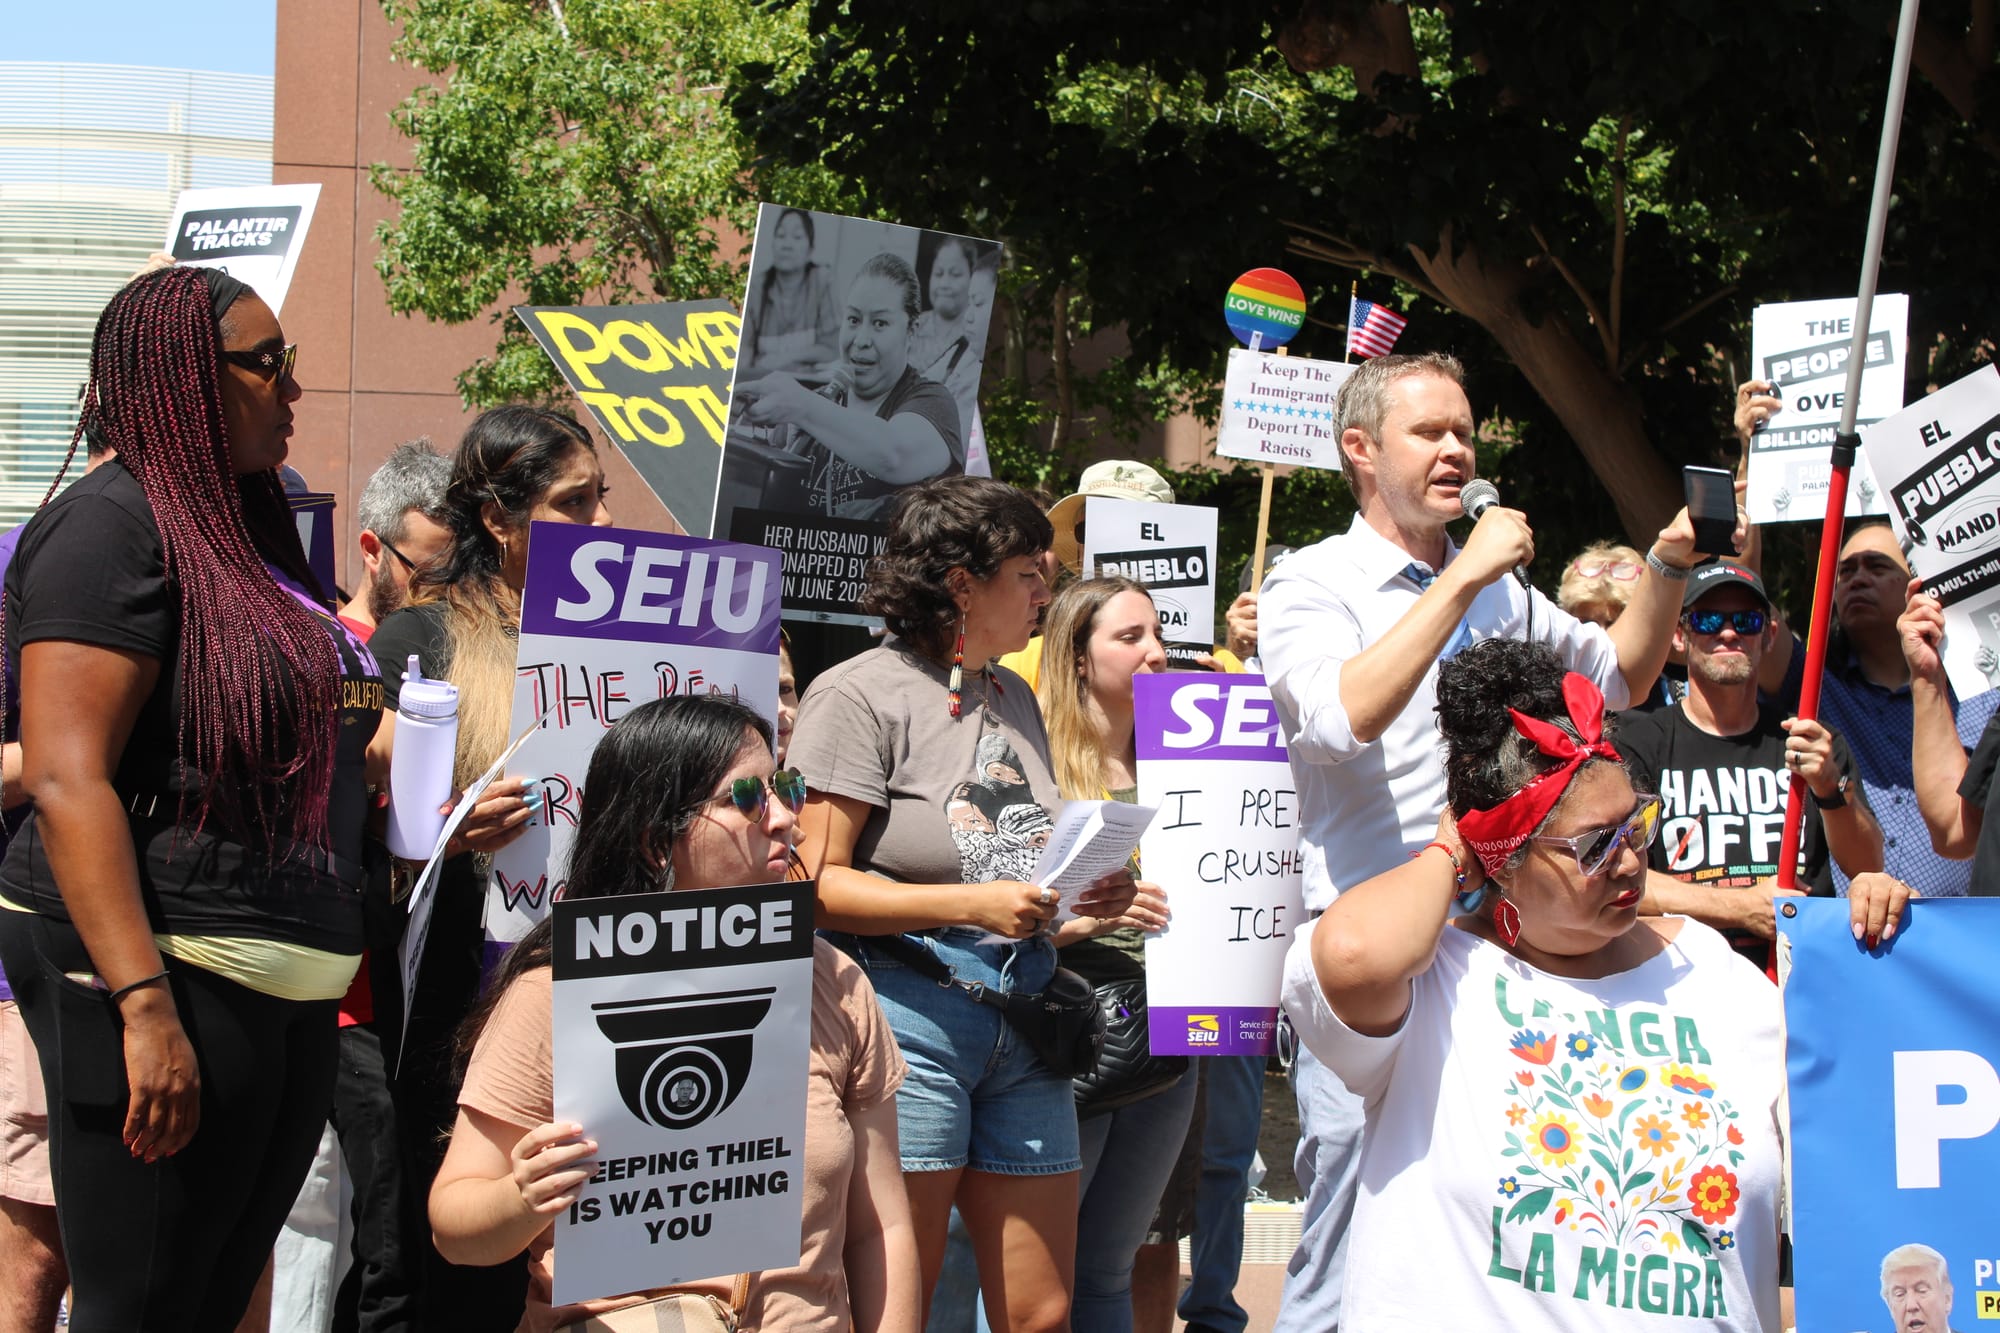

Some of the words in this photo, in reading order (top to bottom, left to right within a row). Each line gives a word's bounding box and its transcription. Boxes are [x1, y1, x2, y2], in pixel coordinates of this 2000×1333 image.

[184, 217, 289, 237] PALANTIR
[192, 232, 273, 251] TRACKS
[1228, 297, 1265, 316] LOVE
[1268, 307, 1301, 326] WINS
[1805, 318, 1850, 336] THE
[1261, 361, 1299, 381] Keep
[1304, 366, 1332, 382] The
[1771, 339, 1885, 382] PEOPE
[1250, 382, 1335, 405] Immigrants
[1796, 392, 1860, 412] OVE
[577, 391, 685, 447] TO
[1247, 416, 1299, 436] Deport
[1303, 423, 1331, 439] The
[1920, 420, 1952, 447] EL
[1260, 440, 1312, 458] Racists
[764, 525, 792, 549] HER
[797, 528, 868, 555] HUSBAND
[873, 535, 889, 556] W
[1141, 522, 1165, 541] EL
[848, 557, 868, 579] BY
[555, 540, 768, 634] SEIU
[798, 577, 835, 600] JUNE
[837, 581, 873, 603] 202
[517, 661, 630, 729] THE
[1162, 789, 1202, 830] I
[575, 900, 793, 960] NOTICE
[1228, 906, 1286, 942] ICE
[1187, 1031, 1219, 1042] SEIU
[1239, 1020, 1262, 1029] Service
[1256, 1031, 1268, 1040] CLC
[702, 1136, 791, 1167] THIEL
[570, 1197, 601, 1225] IS
[609, 1170, 789, 1217] WATCHING
[645, 1213, 712, 1244] YOU
[1487, 1206, 1556, 1293] LA
